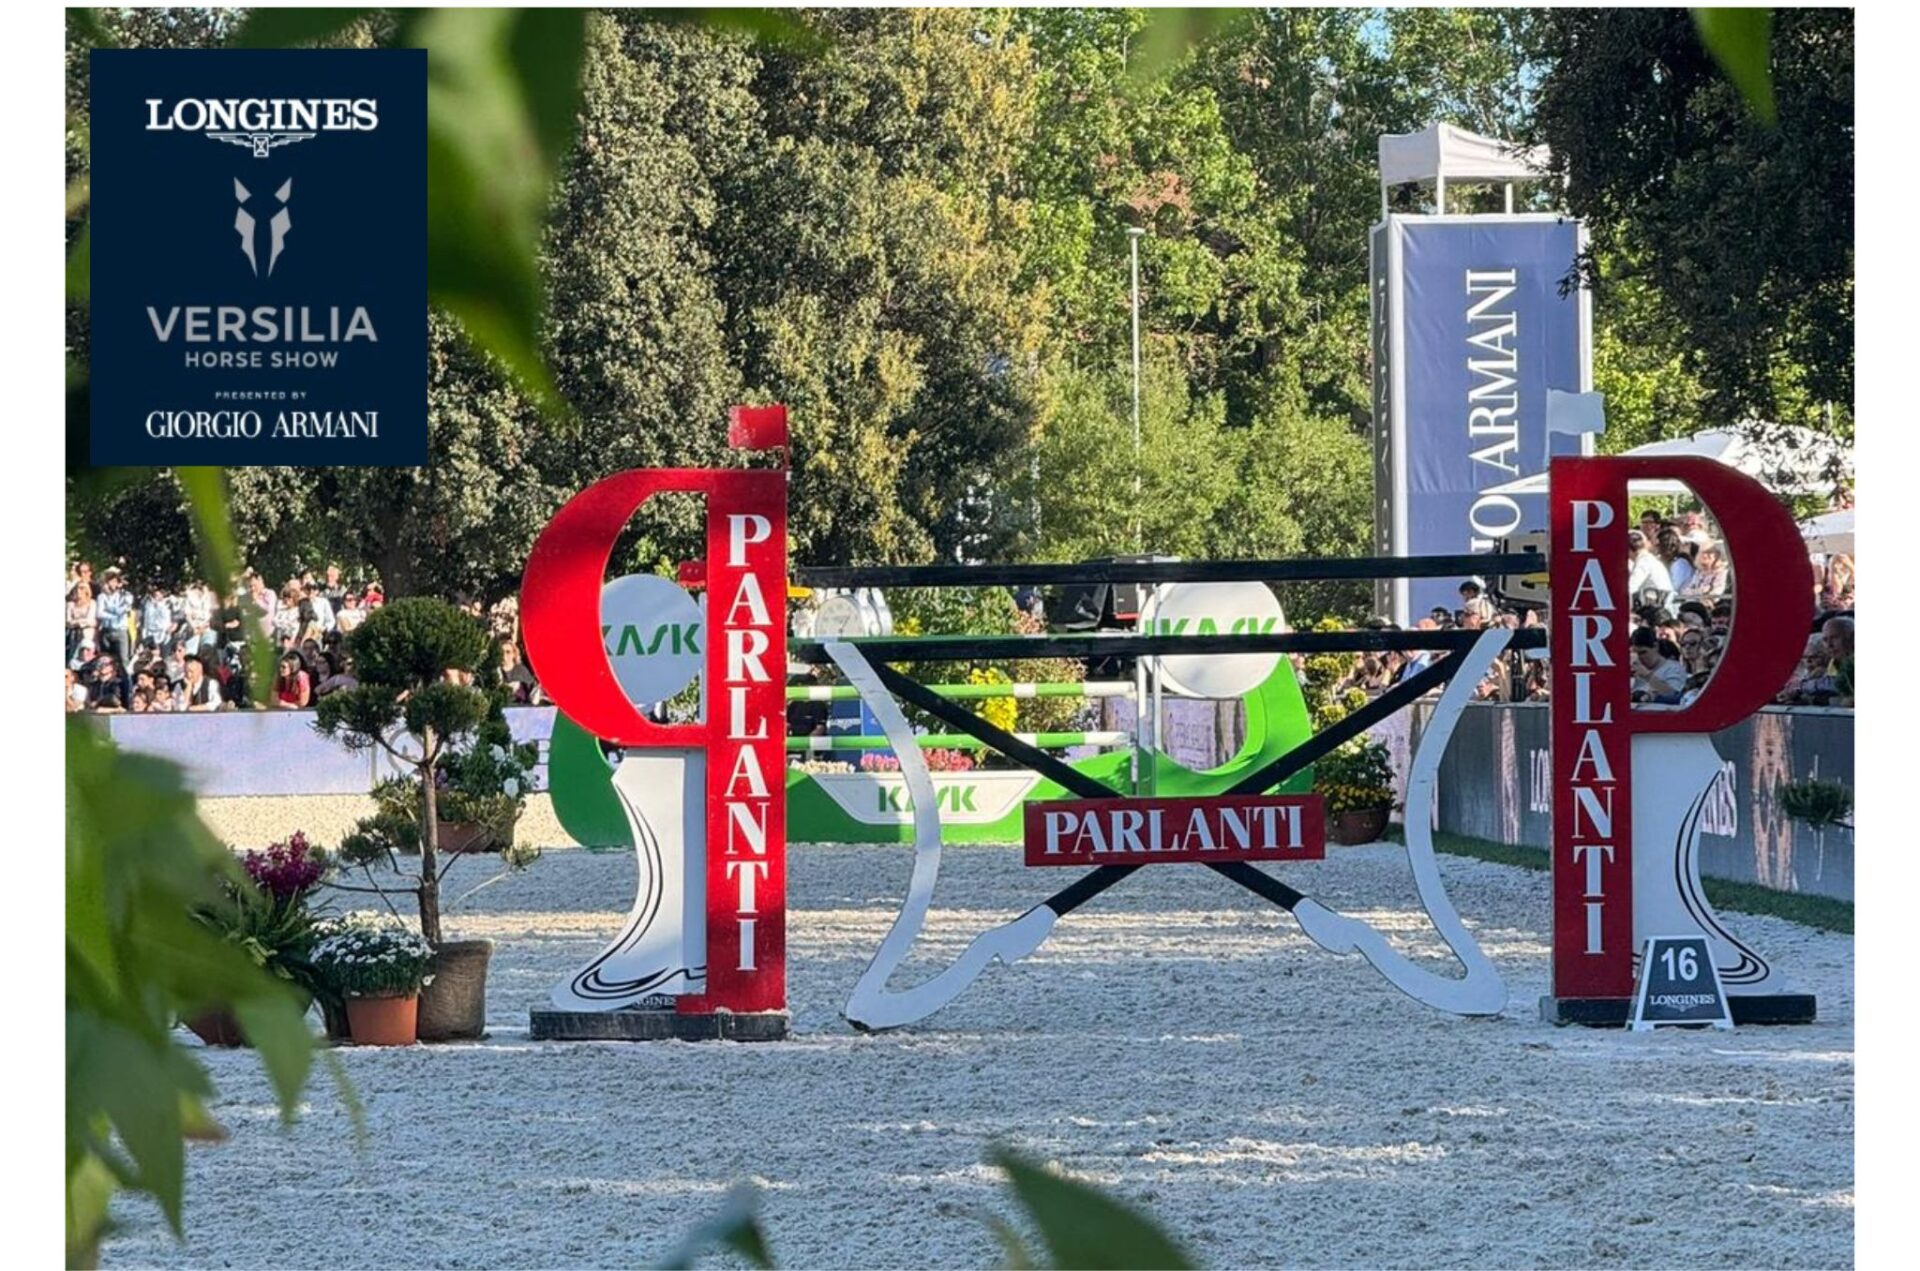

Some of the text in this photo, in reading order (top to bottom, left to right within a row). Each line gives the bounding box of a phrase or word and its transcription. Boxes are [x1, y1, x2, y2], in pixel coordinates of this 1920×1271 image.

[1466, 269, 1519, 475] ARMANI
[724, 514, 773, 971] PARLANTI
[1569, 500, 1616, 955] PARLANTI
[879, 786, 977, 812] KSK
[1044, 805, 1304, 854] PARLANTI
[1660, 944, 1698, 981] 16
[1649, 994, 1715, 1005] LONGINES
